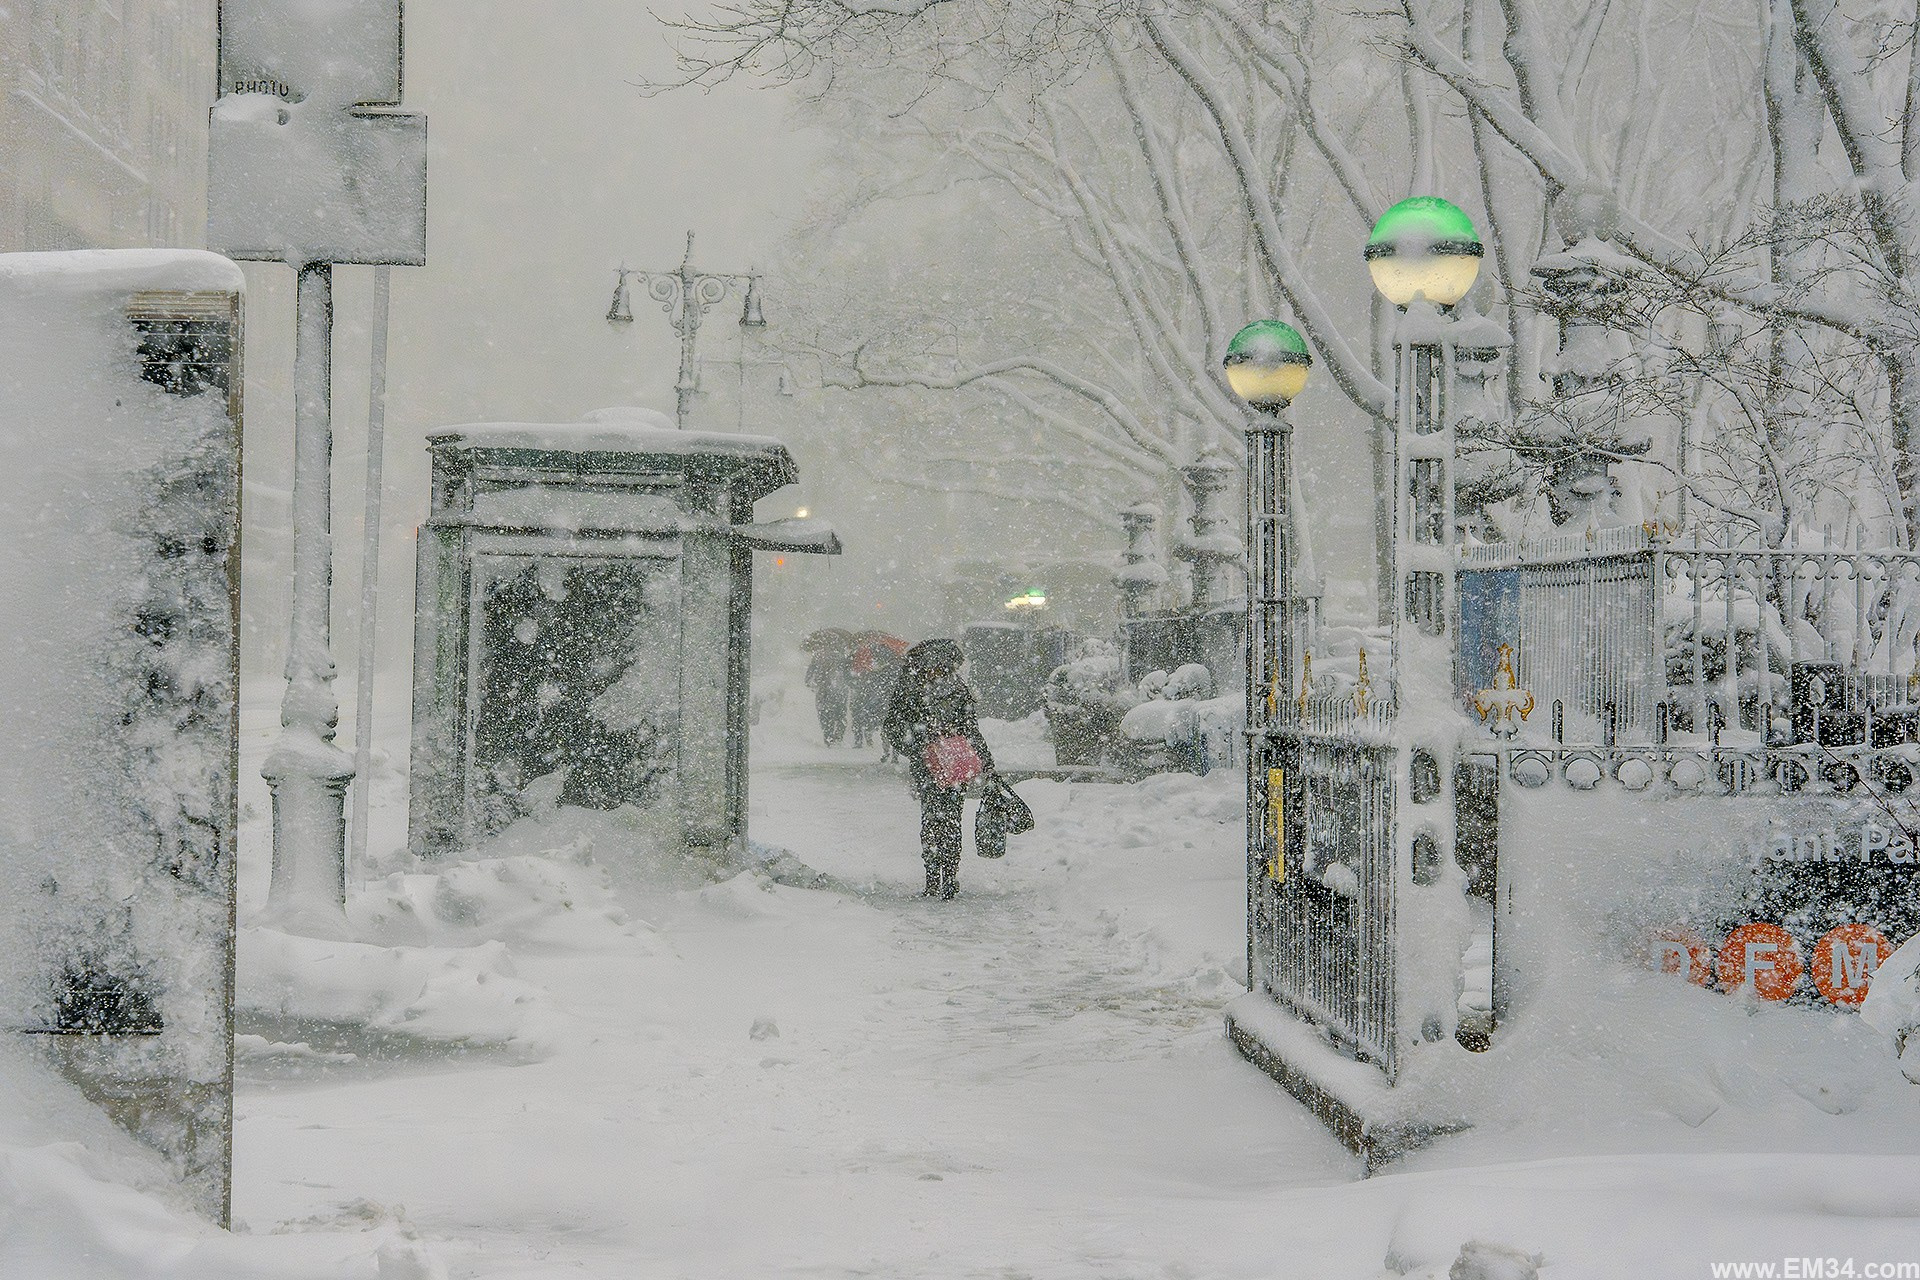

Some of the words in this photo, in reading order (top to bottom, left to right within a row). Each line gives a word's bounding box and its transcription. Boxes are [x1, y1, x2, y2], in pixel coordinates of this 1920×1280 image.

[1861, 824, 1920, 864] Pa
[1745, 942, 1778, 990] F
[1831, 941, 1877, 989] M
